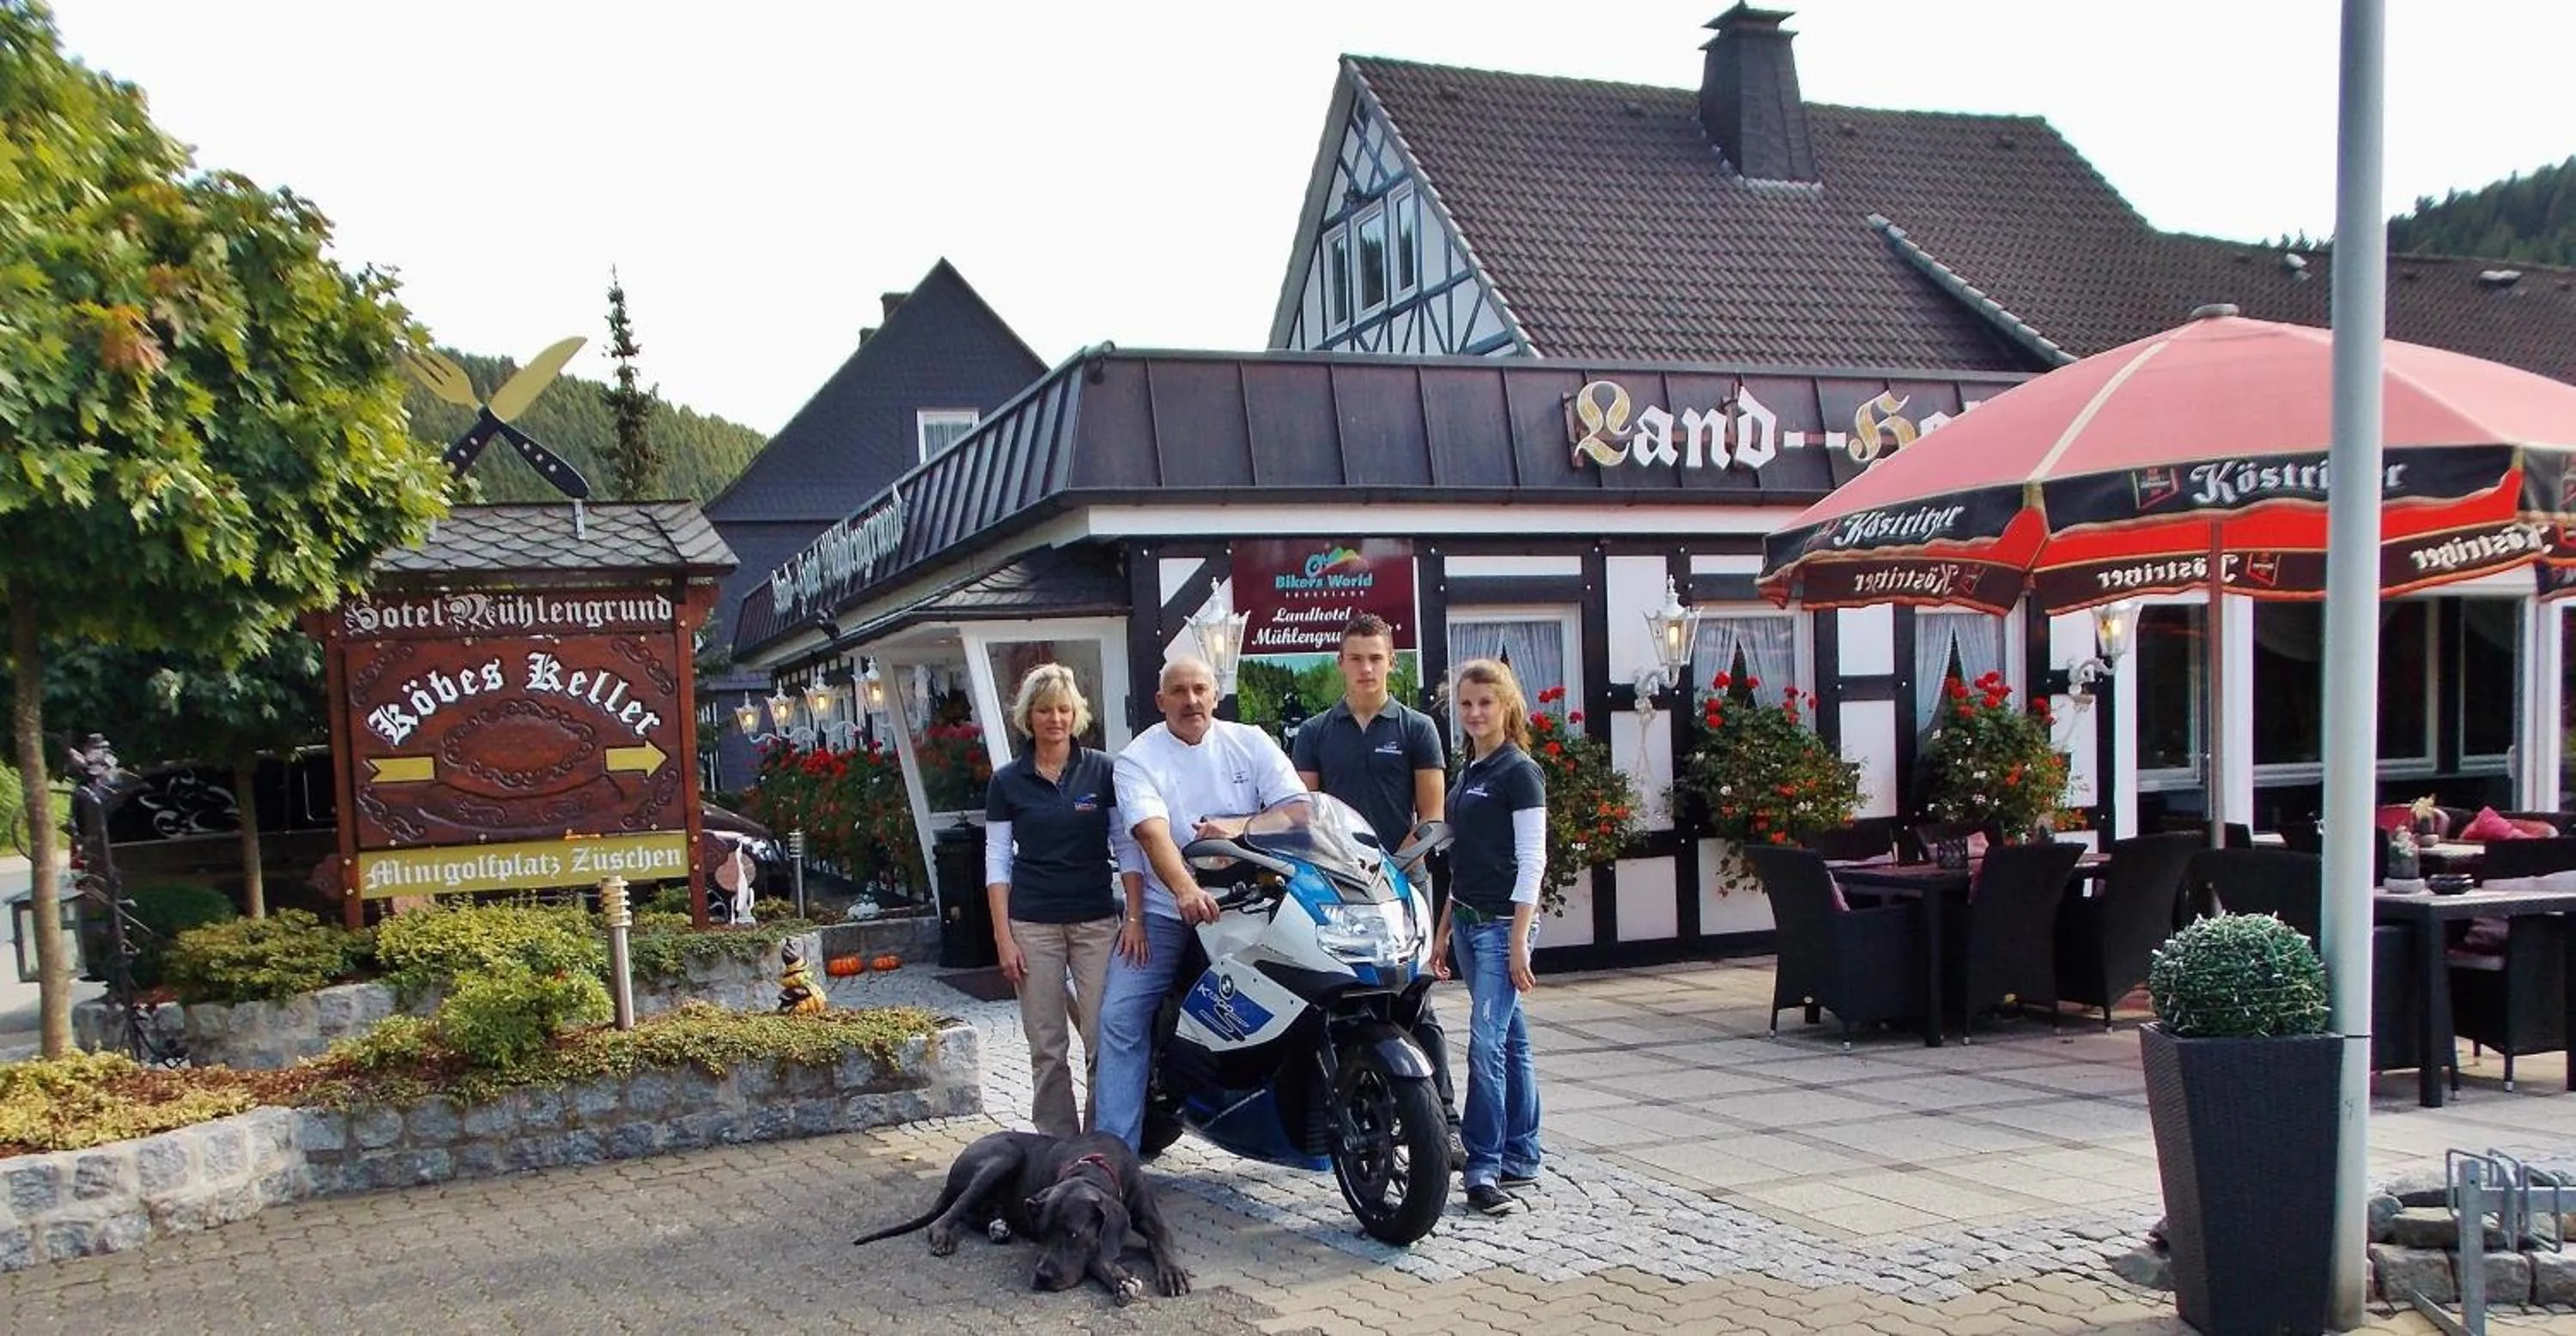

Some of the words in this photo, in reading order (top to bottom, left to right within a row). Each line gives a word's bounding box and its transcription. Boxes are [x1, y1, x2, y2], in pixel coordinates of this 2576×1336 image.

[2190, 459, 2408, 504] Köstrir
[1833, 506, 1965, 546] Köstritzer
[1275, 574, 1324, 589] Bikers
[1327, 573, 1373, 588] World
[345, 598, 444, 635] Hotel
[446, 593, 672, 632] Mühlengrund
[1272, 605, 1352, 622] Landhotel
[368, 659, 504, 746] Köbes
[526, 652, 661, 736] Keller
[365, 852, 562, 890] Minigolfplatz
[571, 846, 682, 872] Züschen
